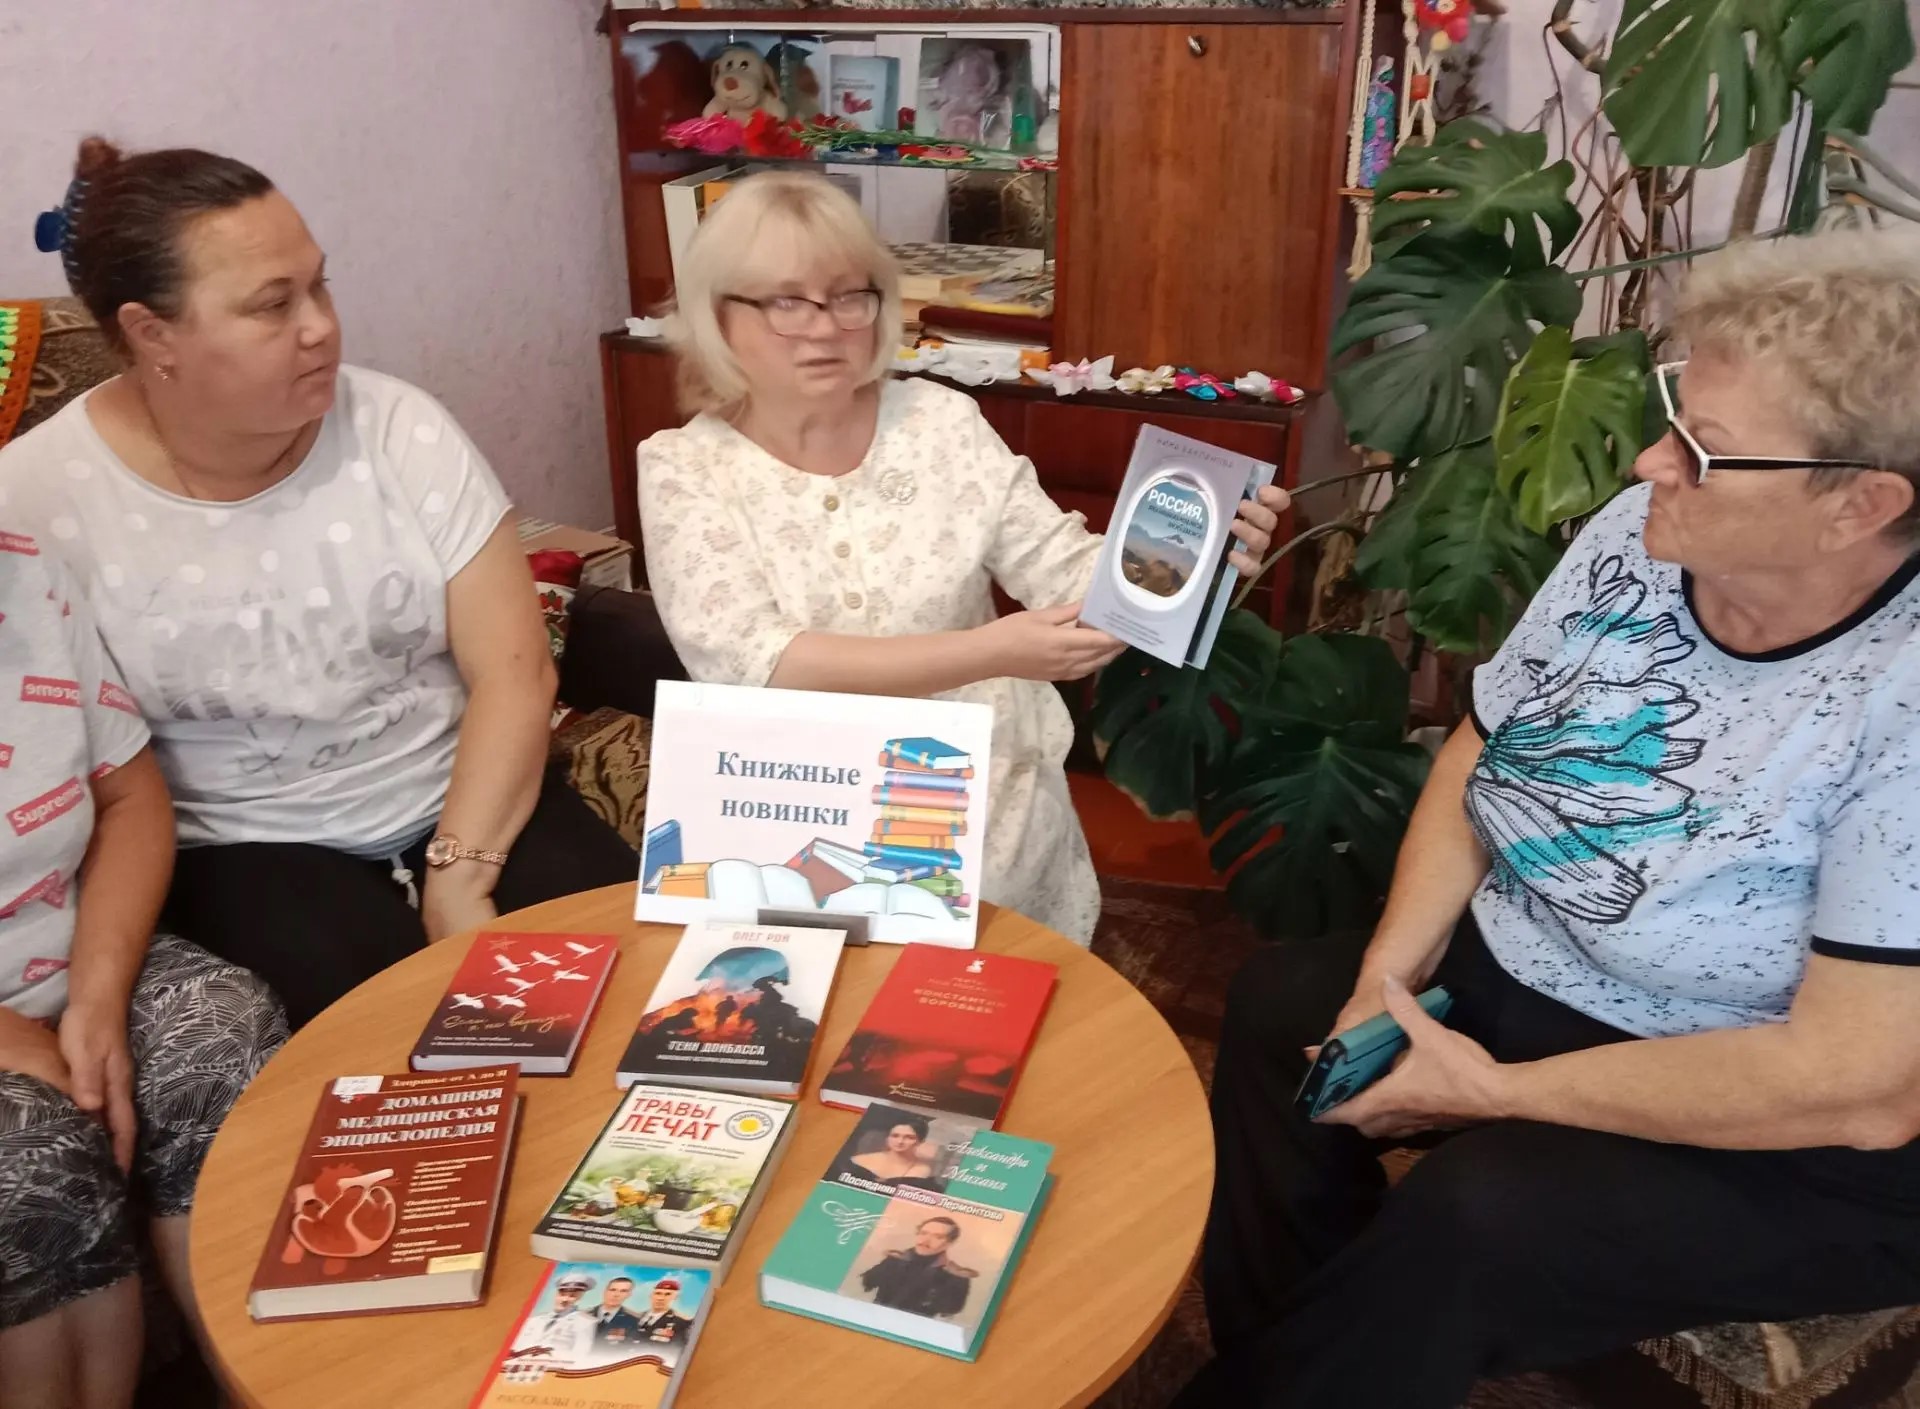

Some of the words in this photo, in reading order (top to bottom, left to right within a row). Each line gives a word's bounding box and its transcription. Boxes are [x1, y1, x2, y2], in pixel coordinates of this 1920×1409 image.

[1148, 488, 1204, 523] РОССИЯ,
[715, 750, 861, 787] Книжные
[719, 797, 850, 827] новинки
[668, 1040, 701, 1053] ТЕНИ
[700, 1043, 766, 1056] ДОНБАССА
[377, 1087, 505, 1112] ДОМАШНЯЯ
[631, 1098, 718, 1120] ТРАВЫ
[337, 1103, 501, 1130] МЕДИЦИНСКАЯ
[616, 1113, 722, 1142] ЛЕЧАТ
[319, 1121, 497, 1149] ЭНЦИКЛОПЕДИЯ
[837, 1171, 897, 1196] Последняя
[896, 1188, 937, 1206] любовь
[937, 1198, 1004, 1222] Лермонтова
